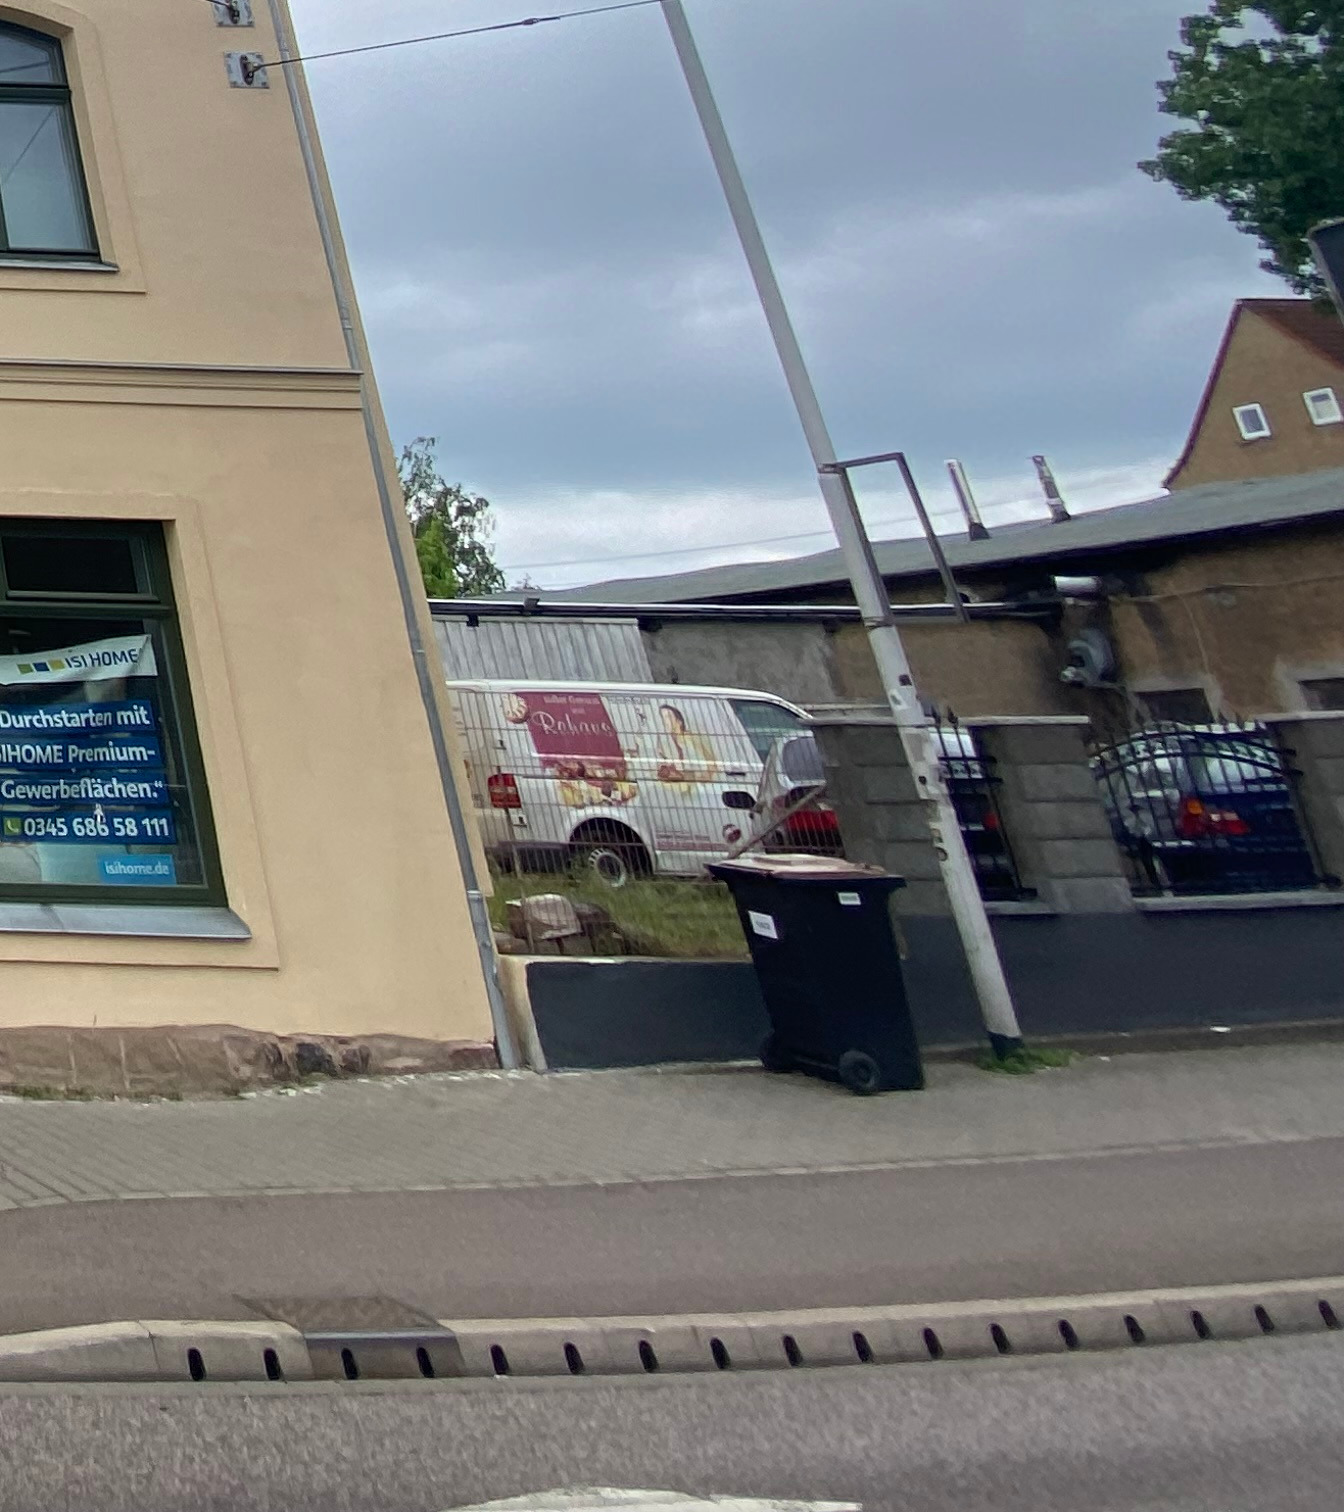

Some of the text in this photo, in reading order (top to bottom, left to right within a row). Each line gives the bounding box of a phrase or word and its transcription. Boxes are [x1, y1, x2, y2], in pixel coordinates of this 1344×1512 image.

[117, 705, 150, 725] mit
[68, 741, 155, 763] Premium-
[1, 777, 163, 799] Gewerbeflächen.“
[24, 818, 169, 836] 0345 686 58 111
[105, 862, 169, 874] isihome.de
